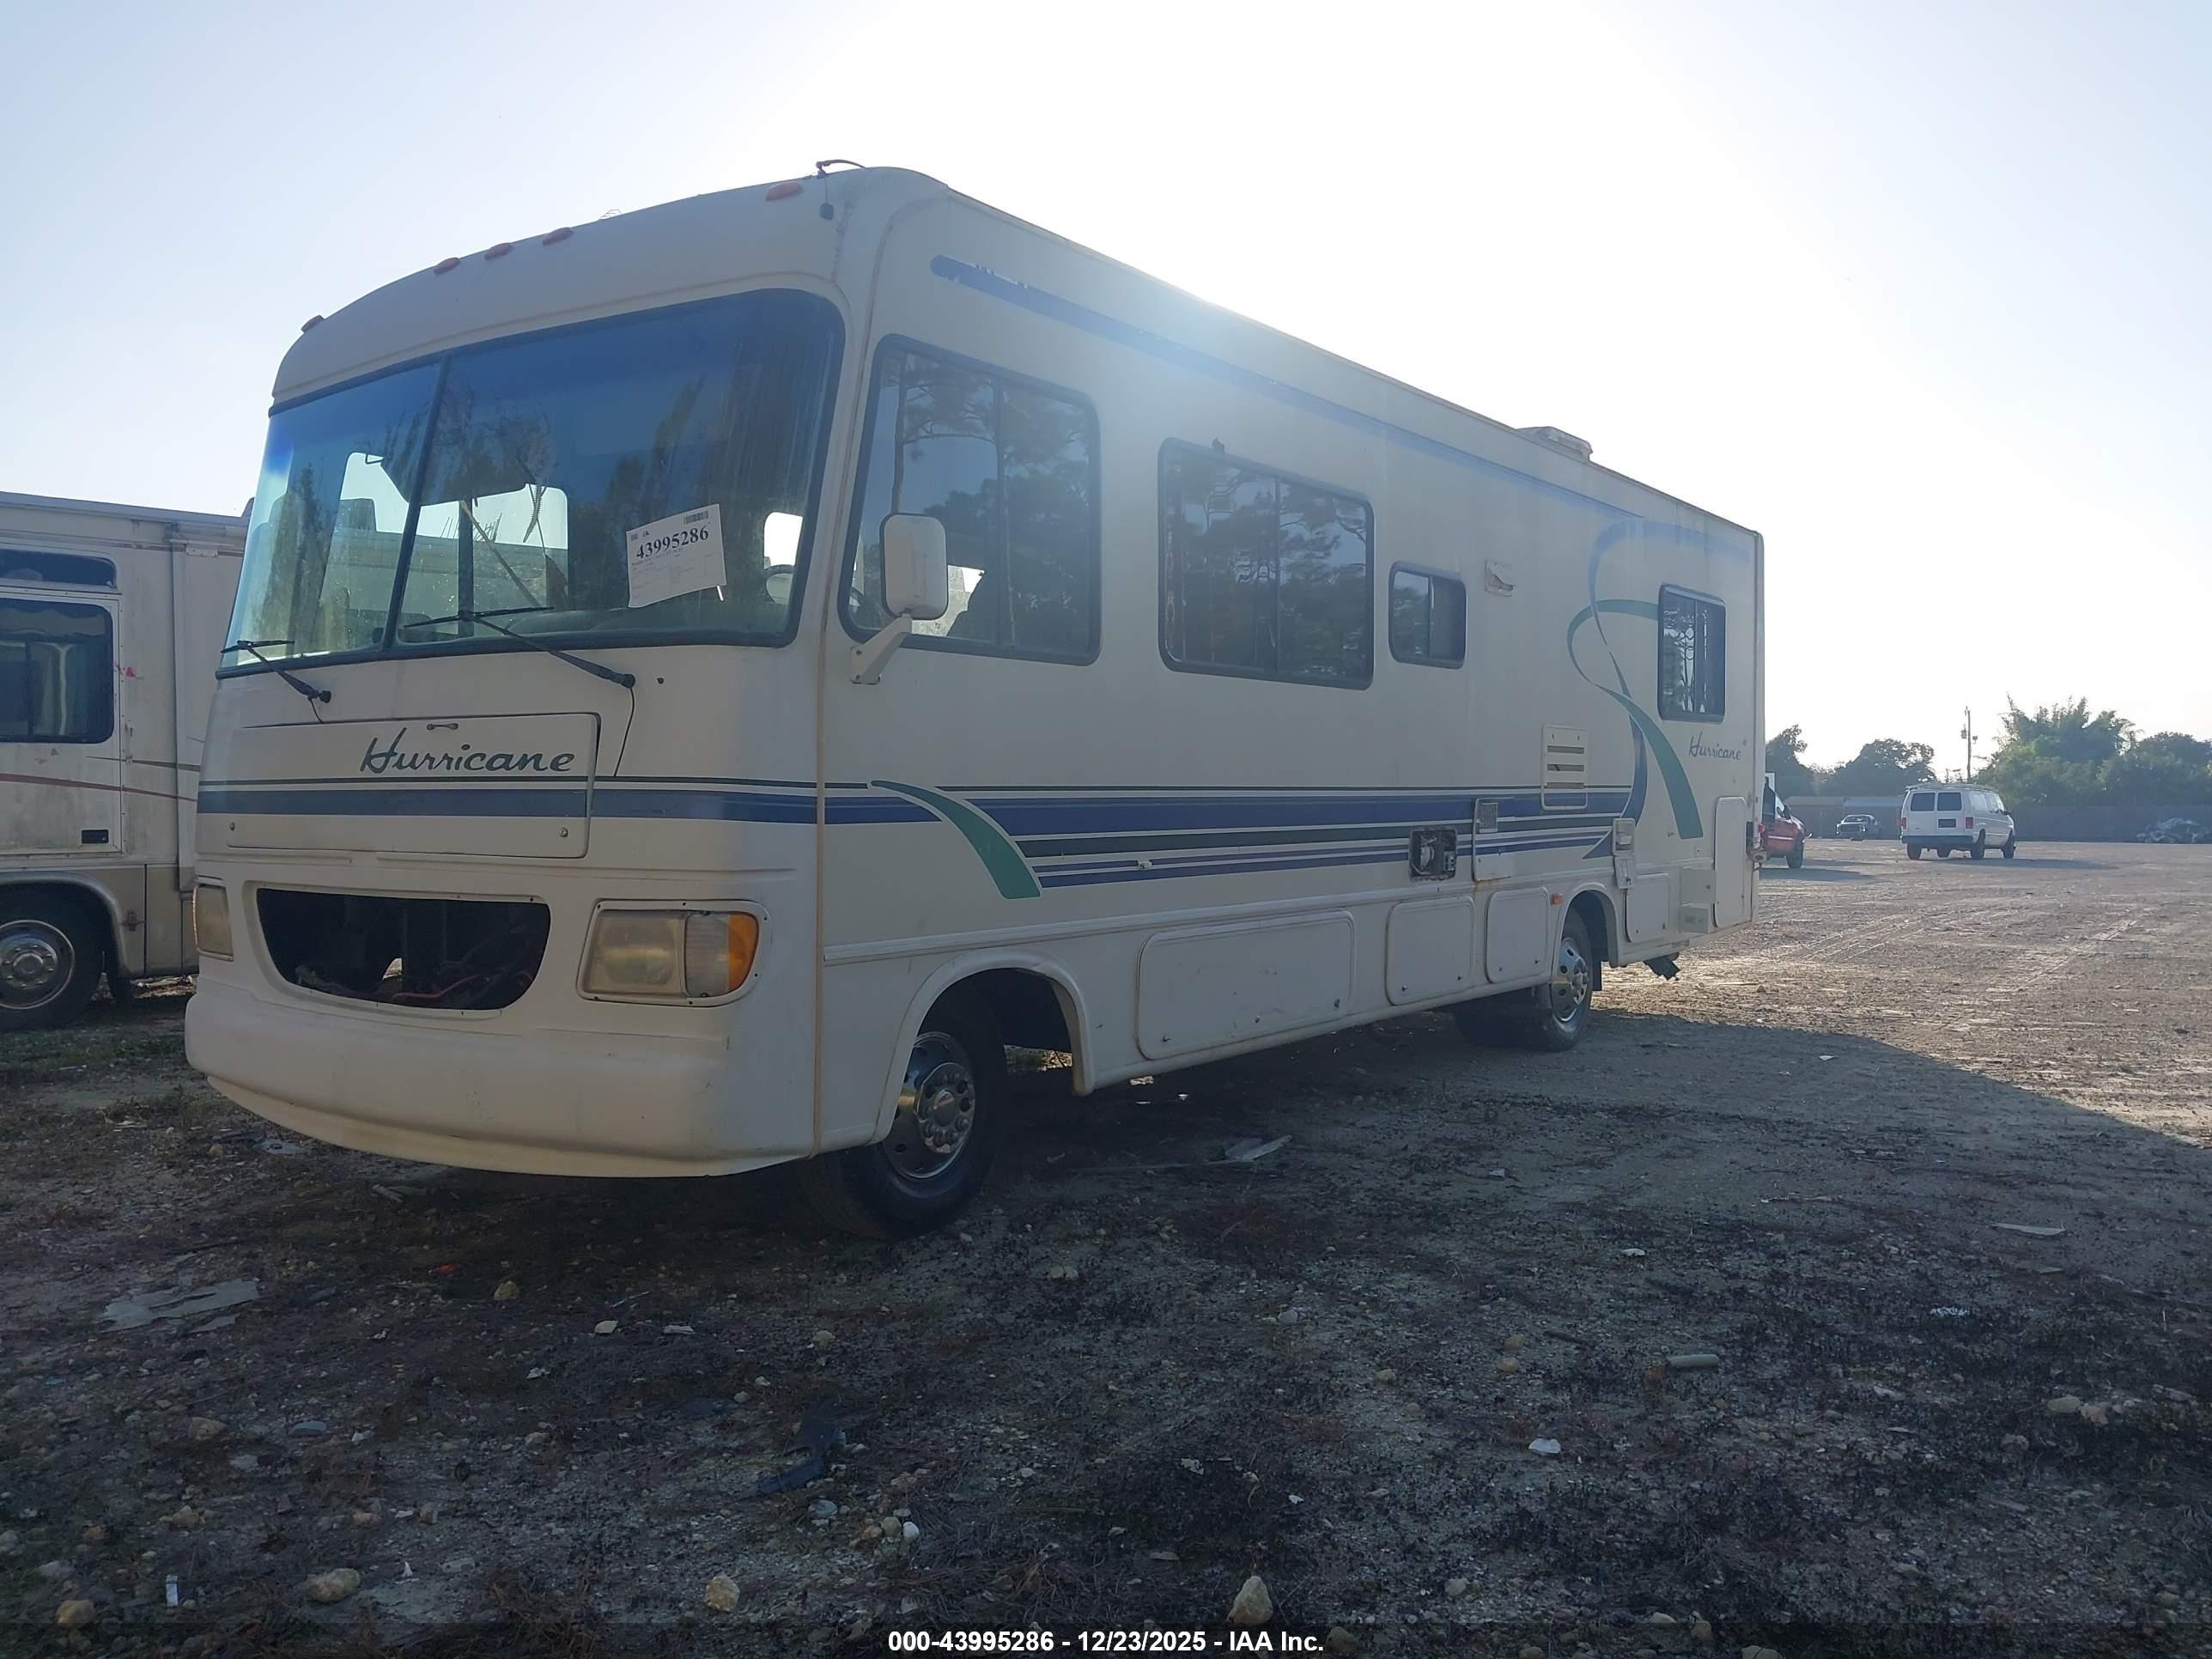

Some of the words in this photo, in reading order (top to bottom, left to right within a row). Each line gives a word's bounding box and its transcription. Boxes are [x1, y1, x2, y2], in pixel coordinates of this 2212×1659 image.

[636, 526, 709, 559] 43995286
[359, 727, 575, 775] Hurricane
[1688, 731, 1742, 761] Hurricane
